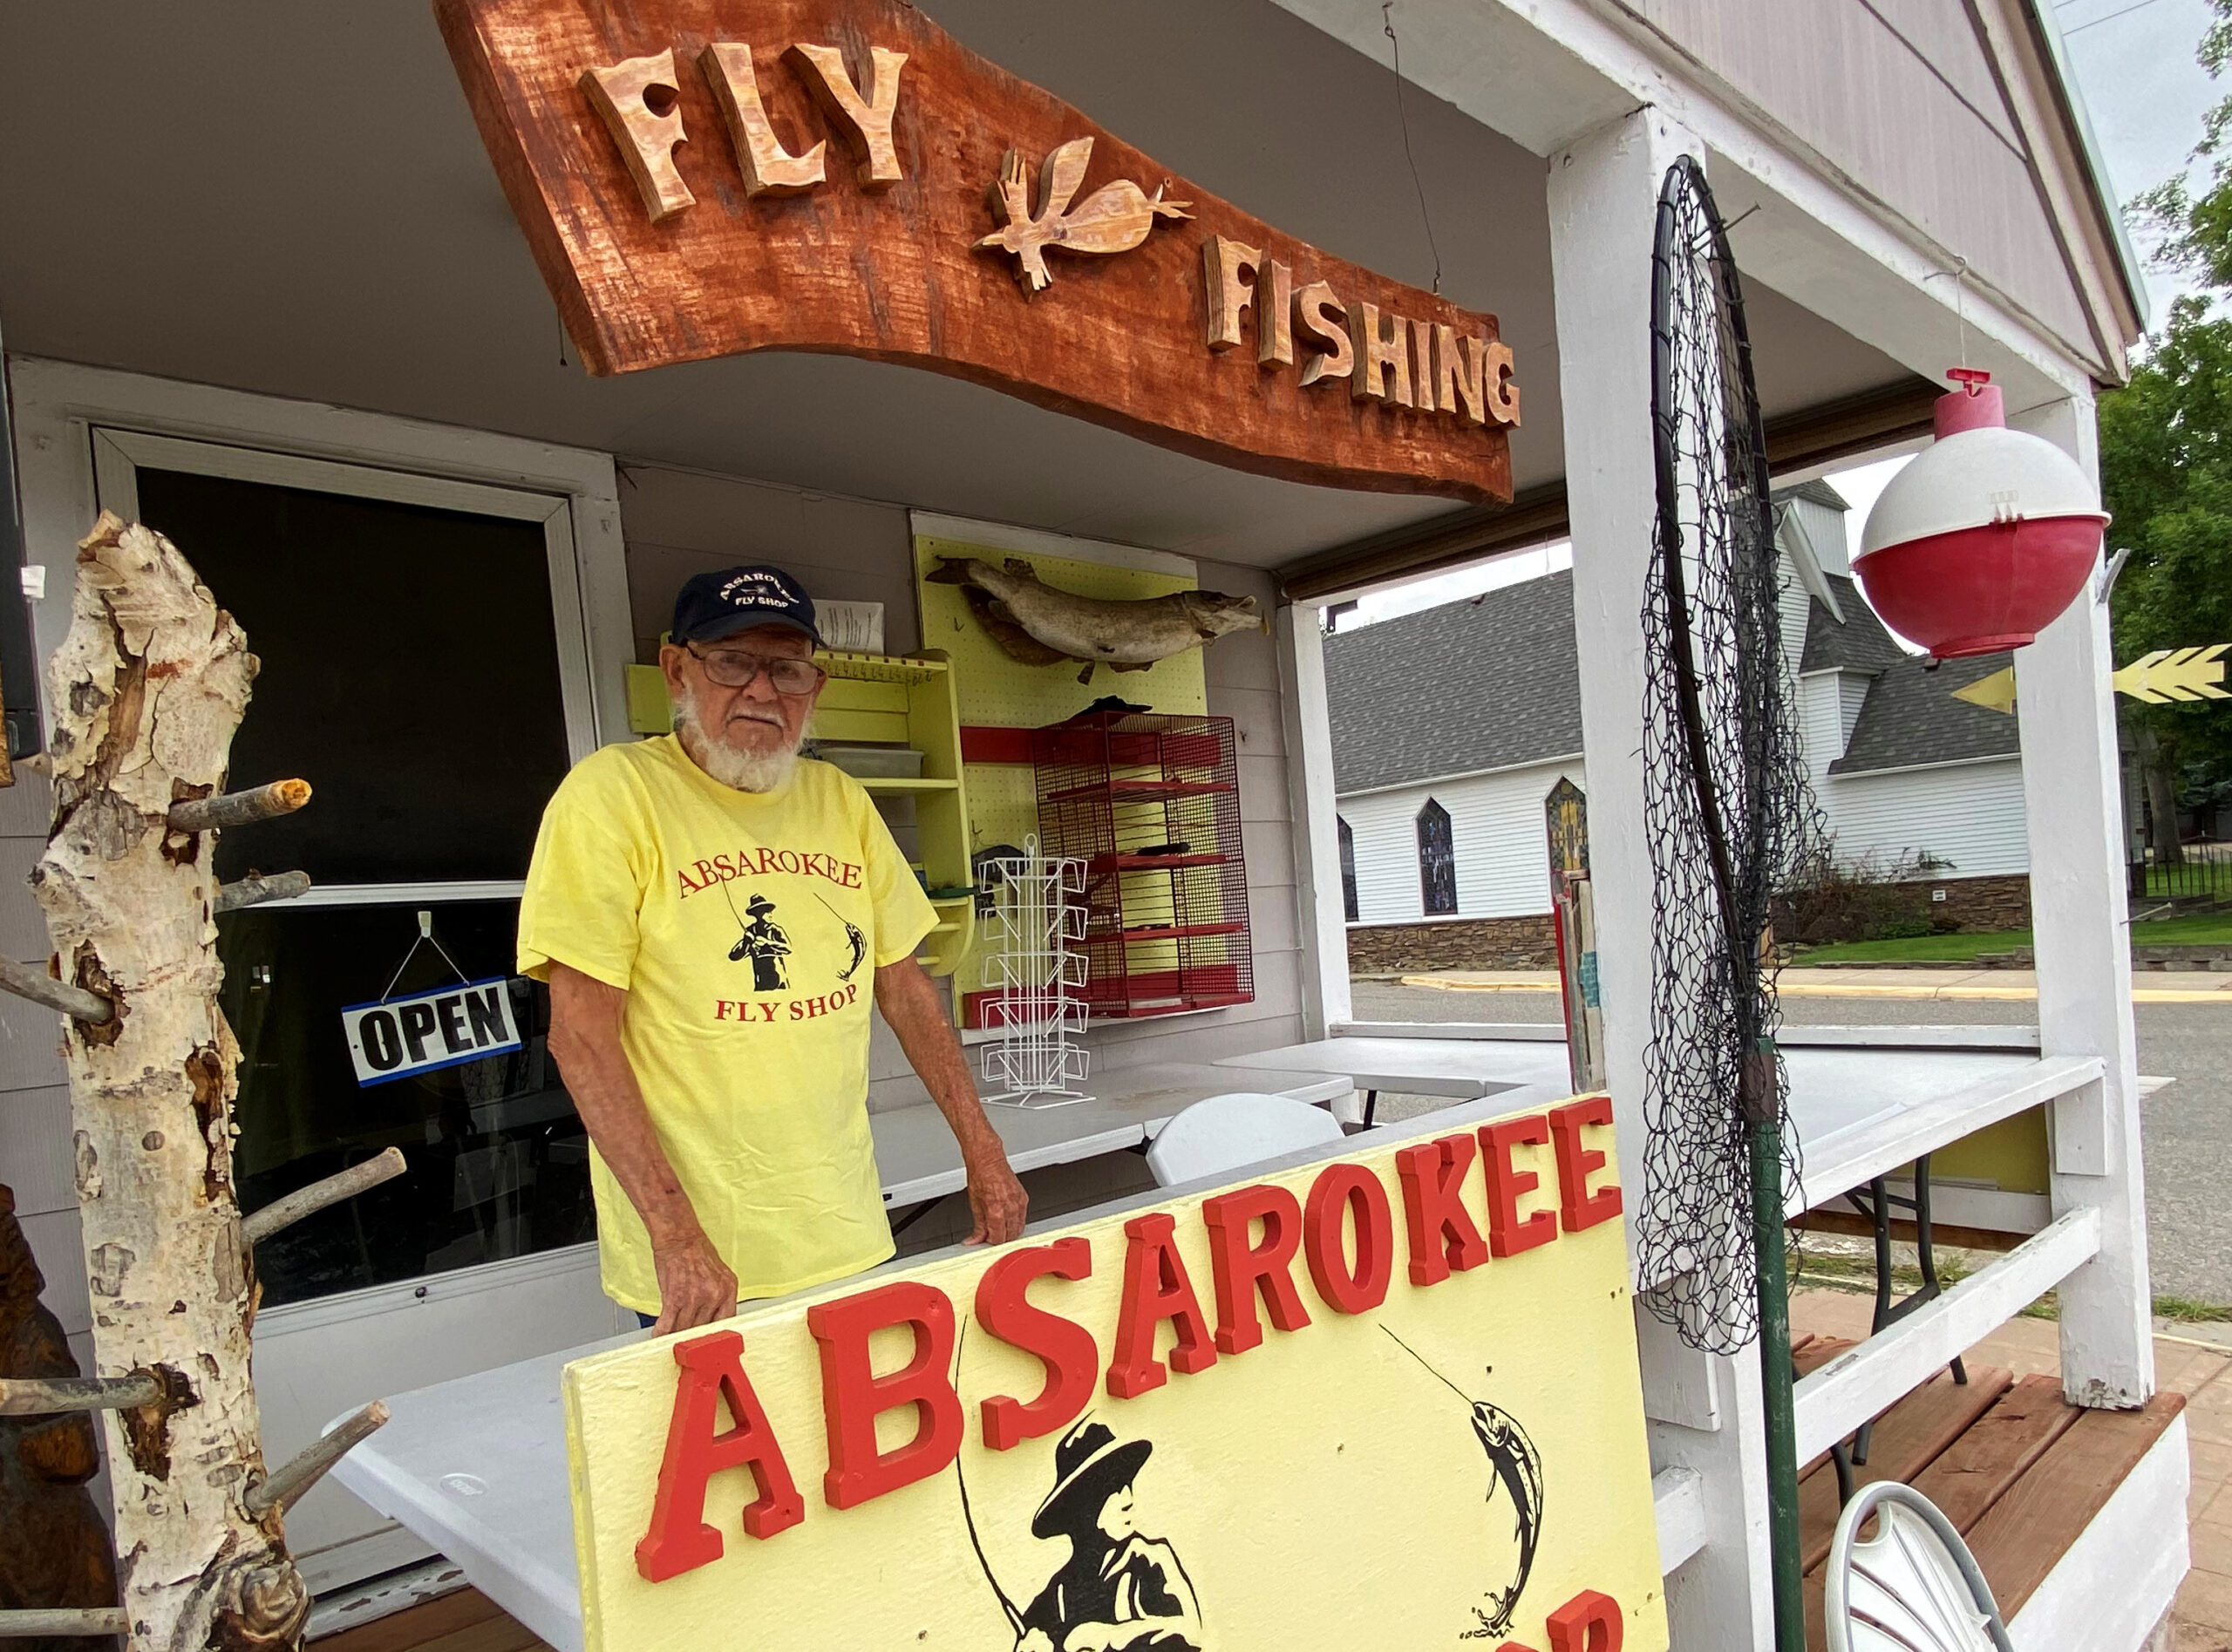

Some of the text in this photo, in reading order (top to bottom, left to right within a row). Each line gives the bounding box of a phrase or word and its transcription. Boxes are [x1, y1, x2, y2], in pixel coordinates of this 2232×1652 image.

[577, 42, 1521, 432] FLY FISHING
[735, 595, 789, 608] FLY SHOP
[677, 847, 862, 900] ABSAROKEE
[358, 986, 510, 1071] OPEN
[714, 983, 857, 1023] FLY SHOP
[636, 1095, 1623, 1583] ABSAROKEE
